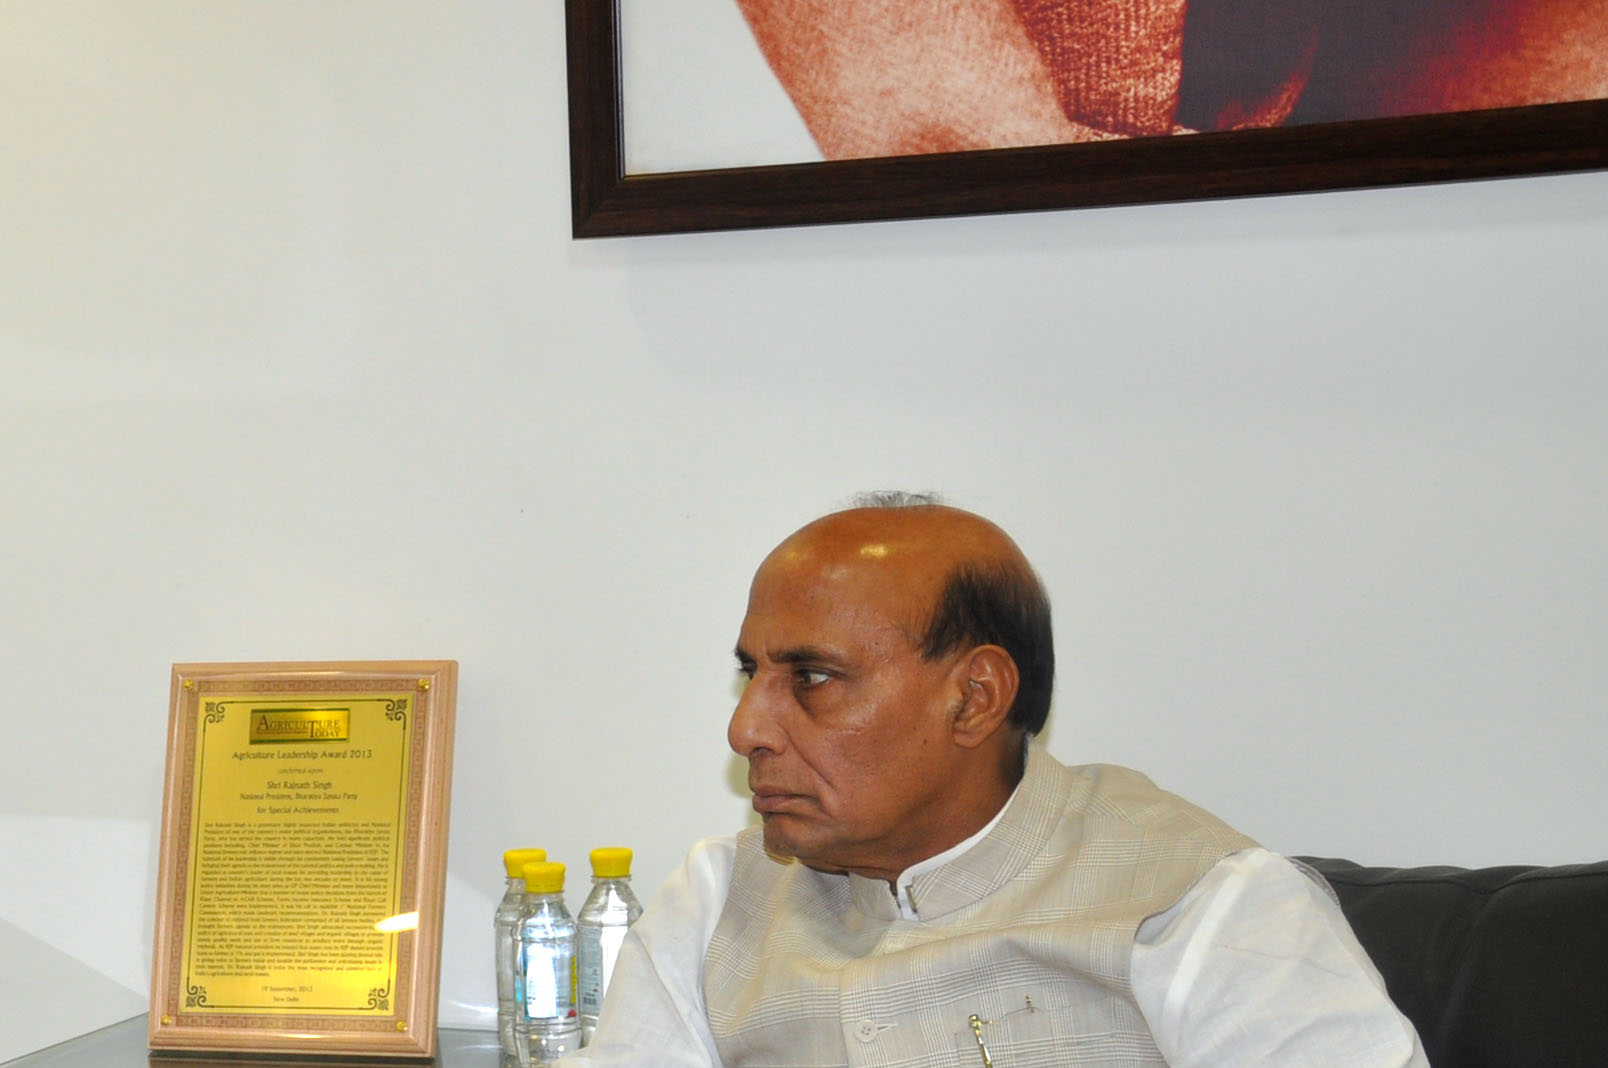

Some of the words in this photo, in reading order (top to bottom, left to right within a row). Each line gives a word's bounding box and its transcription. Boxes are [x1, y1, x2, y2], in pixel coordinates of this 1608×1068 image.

[232, 751, 274, 760] Agriculture
[278, 751, 318, 759] Leadership
[349, 750, 372, 758] 2013
[267, 781, 281, 789] Shri
[284, 781, 310, 789] Rajnath
[313, 781, 332, 790] Singh
